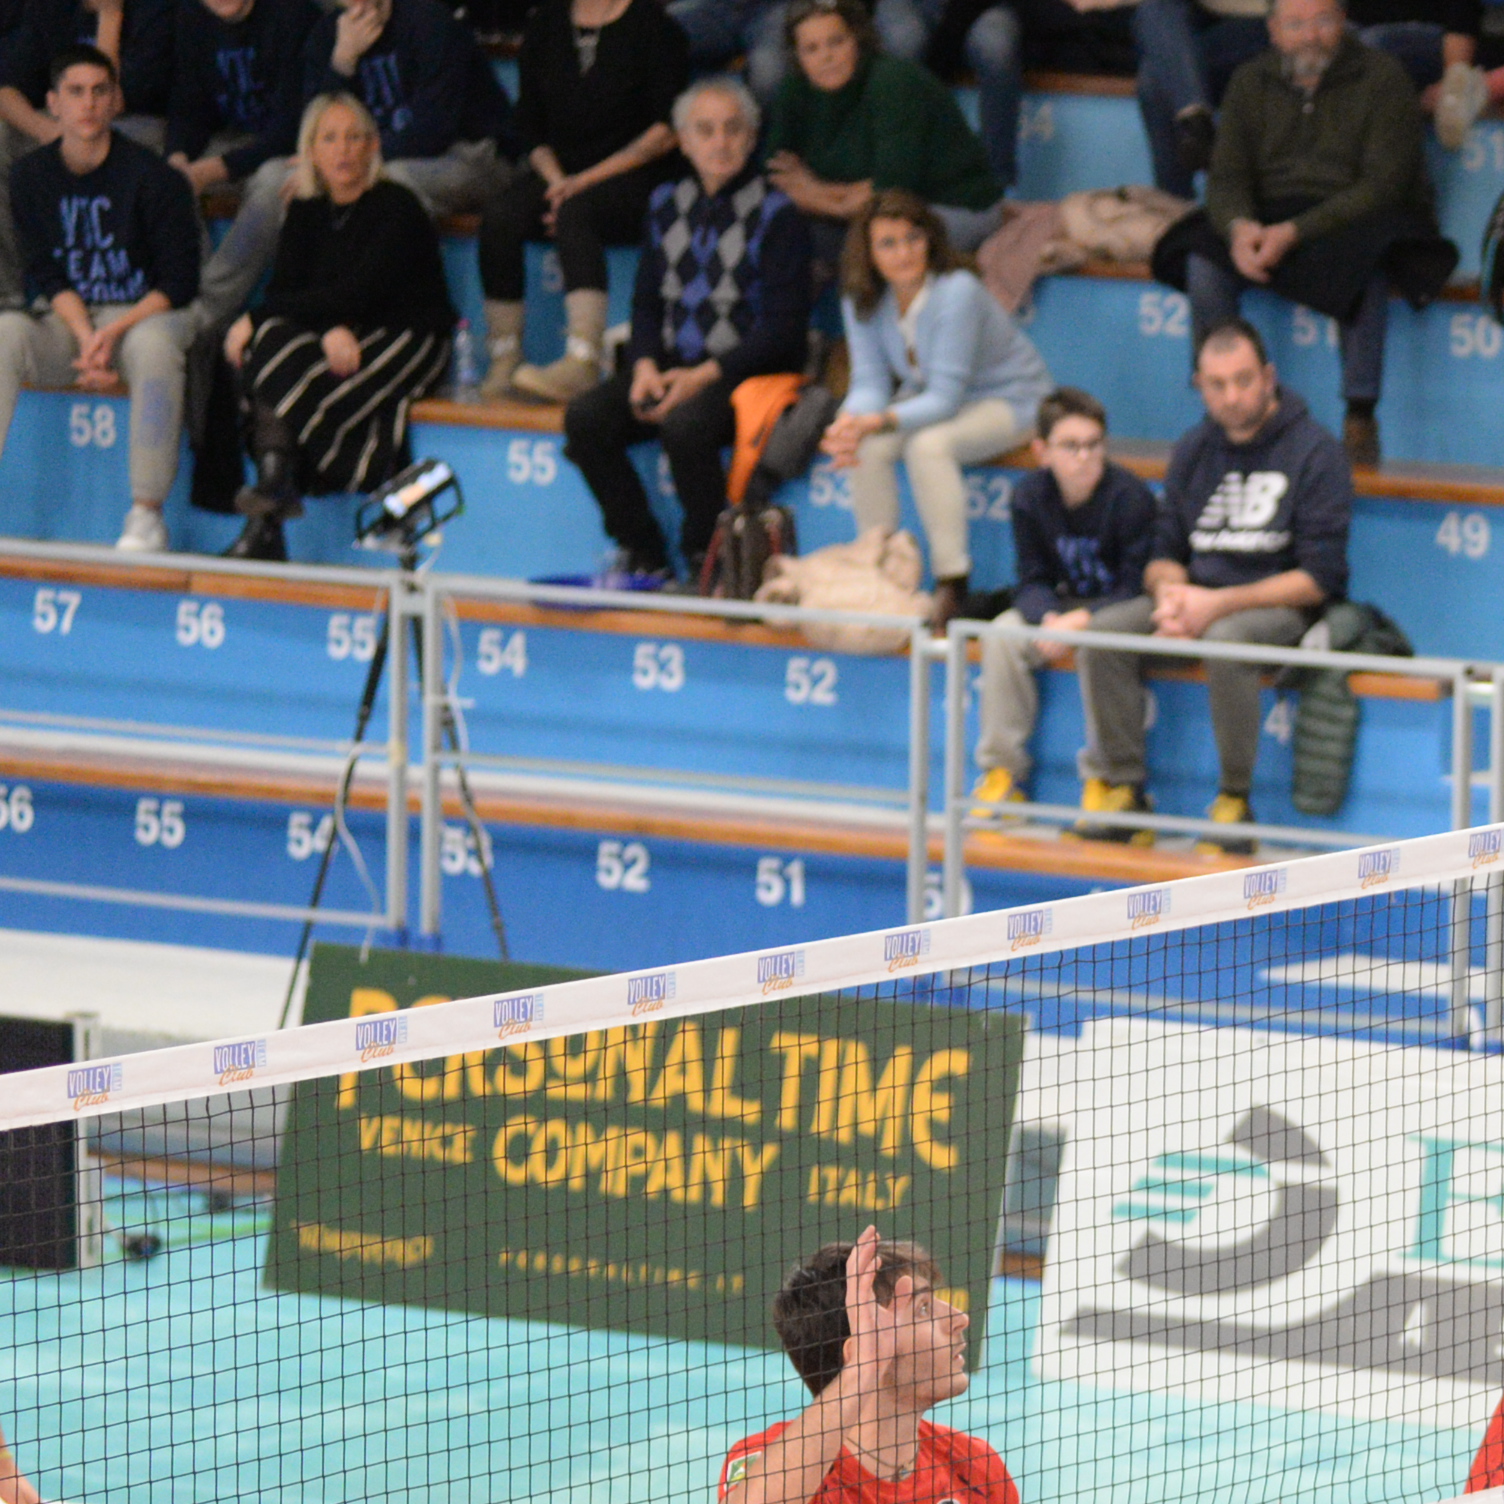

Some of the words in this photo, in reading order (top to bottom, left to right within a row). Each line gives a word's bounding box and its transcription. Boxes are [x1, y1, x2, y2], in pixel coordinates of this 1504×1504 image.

[1139, 293, 1189, 336] 52
[1449, 315, 1503, 358] 50
[70, 404, 117, 448] 58
[507, 440, 556, 486] 55
[1435, 512, 1490, 560] 49
[33, 590, 82, 635] 57
[175, 602, 226, 649] 56
[327, 614, 377, 662] 55
[477, 629, 528, 677] 54
[632, 643, 685, 692] 53
[784, 657, 838, 706] 52
[135, 799, 186, 848] 55
[287, 813, 336, 860] 54
[441, 826, 493, 876] 53
[596, 841, 650, 893] 52
[1358, 849, 1392, 879] VOLLEY
[755, 858, 806, 908] 51
[1243, 870, 1278, 899] VOLLEY
[1007, 911, 1043, 940] VOLLEY
[1127, 890, 1162, 920] VOLLEY
[757, 952, 794, 983] VOLLEY
[884, 931, 921, 961] VOLLEY
[627, 974, 666, 1004] VOLLEY
[494, 996, 533, 1028] VOLLEY
[499, 1017, 531, 1040] Club
[356, 1018, 396, 1052] VOLLEY
[361, 1041, 395, 1063] Club
[214, 1041, 255, 1074] VOLLEY
[219, 1067, 255, 1087] Club
[68, 1064, 111, 1099] VOLLEY
[73, 1089, 109, 1112] Club
[771, 1030, 973, 1172] TIME
[357, 1115, 477, 1165] VENICE
[492, 1113, 780, 1212] COMPANY
[807, 1165, 911, 1212] ITALY
